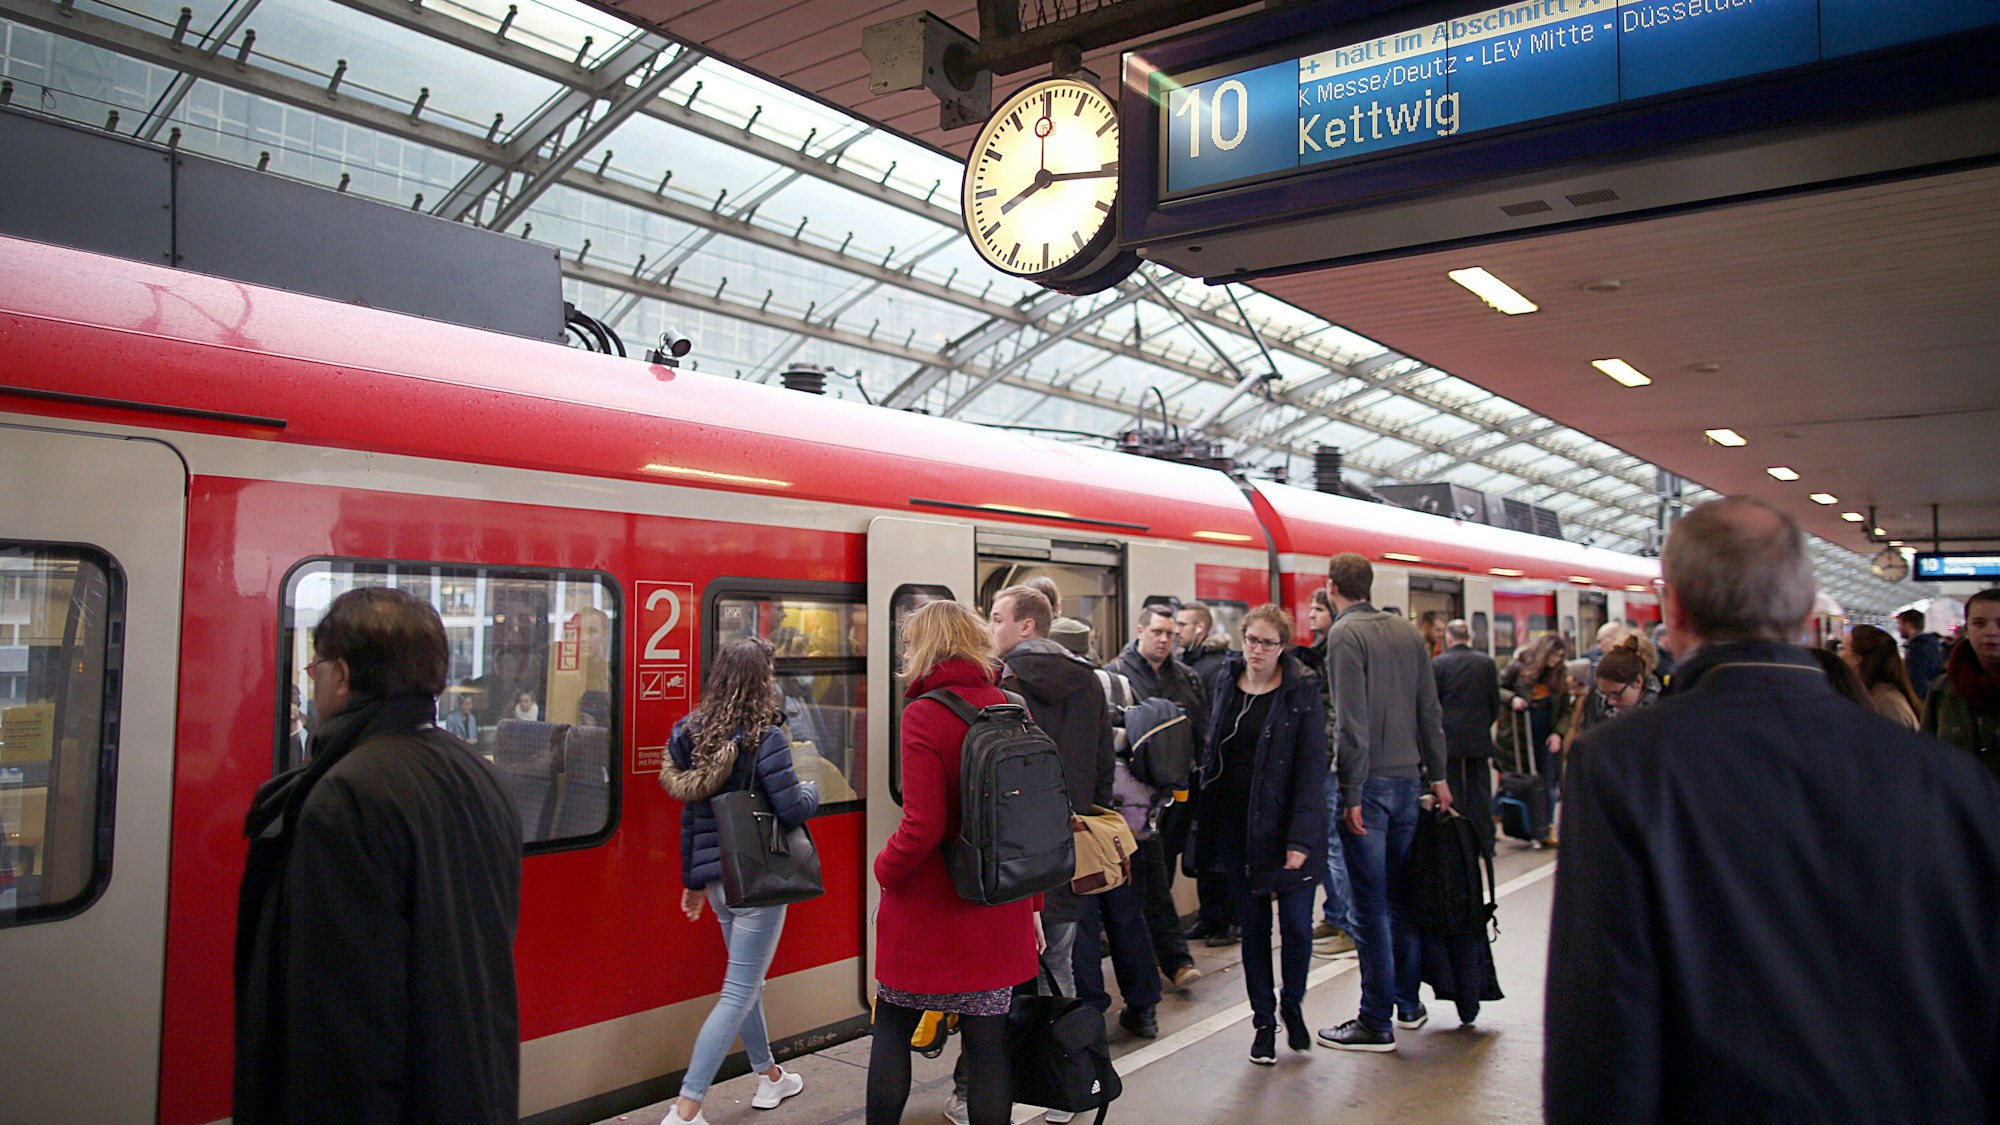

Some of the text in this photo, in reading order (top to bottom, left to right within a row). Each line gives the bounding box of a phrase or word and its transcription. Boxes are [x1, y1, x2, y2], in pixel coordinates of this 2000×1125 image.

[1298, 87, 1311, 107] K
[1317, 56, 1458, 101] Messe/Deutz
[1482, 37, 1523, 65] LEV
[1530, 24, 1594, 54] Mitte
[1335, 38, 1387, 67] hält
[1394, 31, 1422, 52] im
[1431, 0, 1568, 45] Abschnitt
[1175, 79, 1249, 158] 10
[1299, 88, 1460, 155] Kettwig
[643, 588, 681, 660] 2
